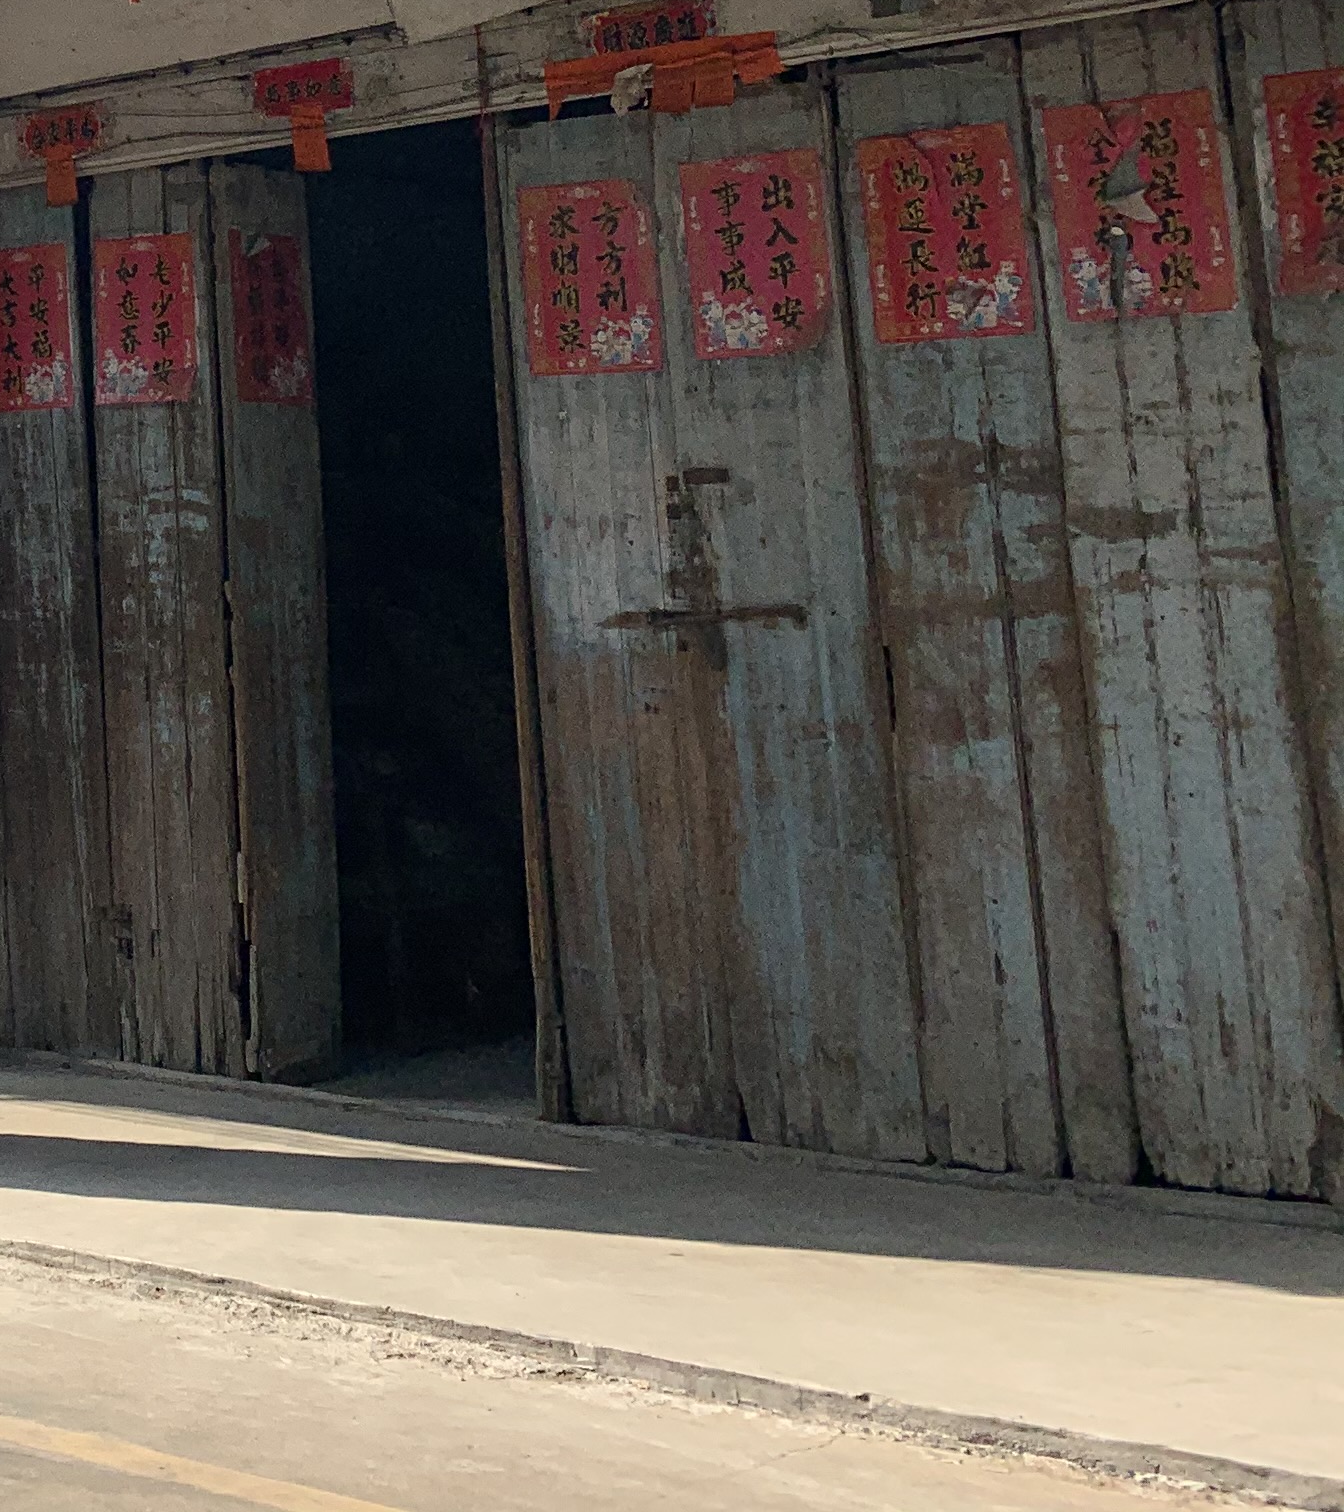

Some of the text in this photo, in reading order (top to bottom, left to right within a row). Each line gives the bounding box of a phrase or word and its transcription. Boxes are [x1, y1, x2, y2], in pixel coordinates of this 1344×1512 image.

[591, 201, 629, 312] 方方利
[711, 180, 753, 297] 事事成
[760, 174, 805, 331] 出入平安
[28, 263, 53, 359] 平安福
[149, 254, 176, 386] 老少平安
